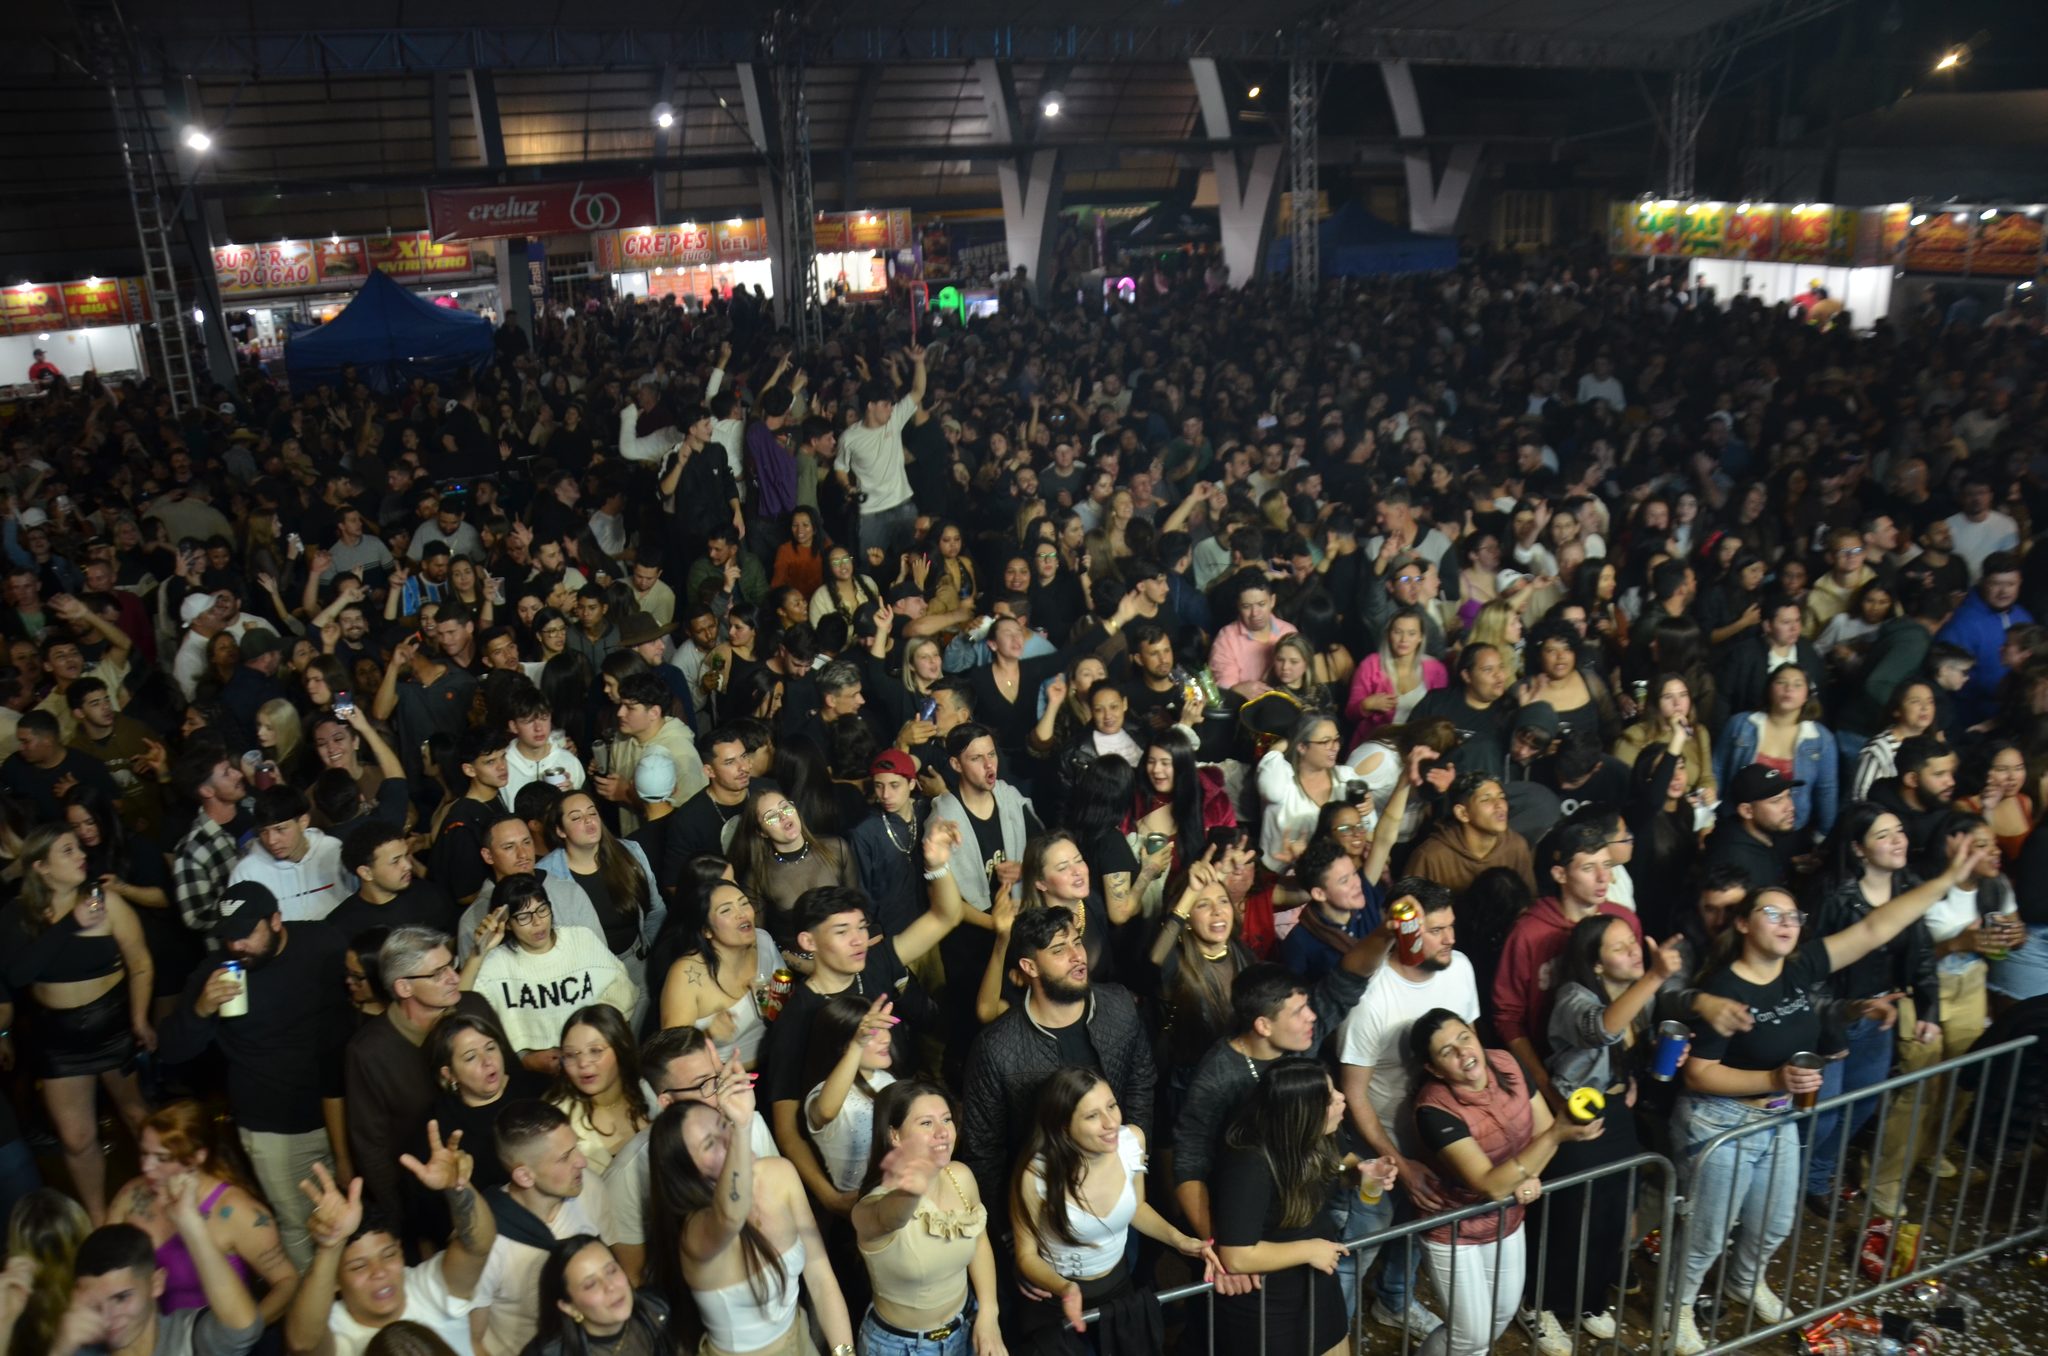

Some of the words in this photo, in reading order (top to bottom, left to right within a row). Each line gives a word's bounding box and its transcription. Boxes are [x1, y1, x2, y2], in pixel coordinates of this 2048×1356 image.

[468, 195, 541, 221] creluz
[323, 241, 360, 255] XIS
[623, 228, 710, 257] CREPES
[213, 249, 282, 271] SUPER
[376, 256, 466, 273] ENTREVERO
[528, 261, 544, 296] Brasil
[501, 971, 594, 1009] LANÇA
